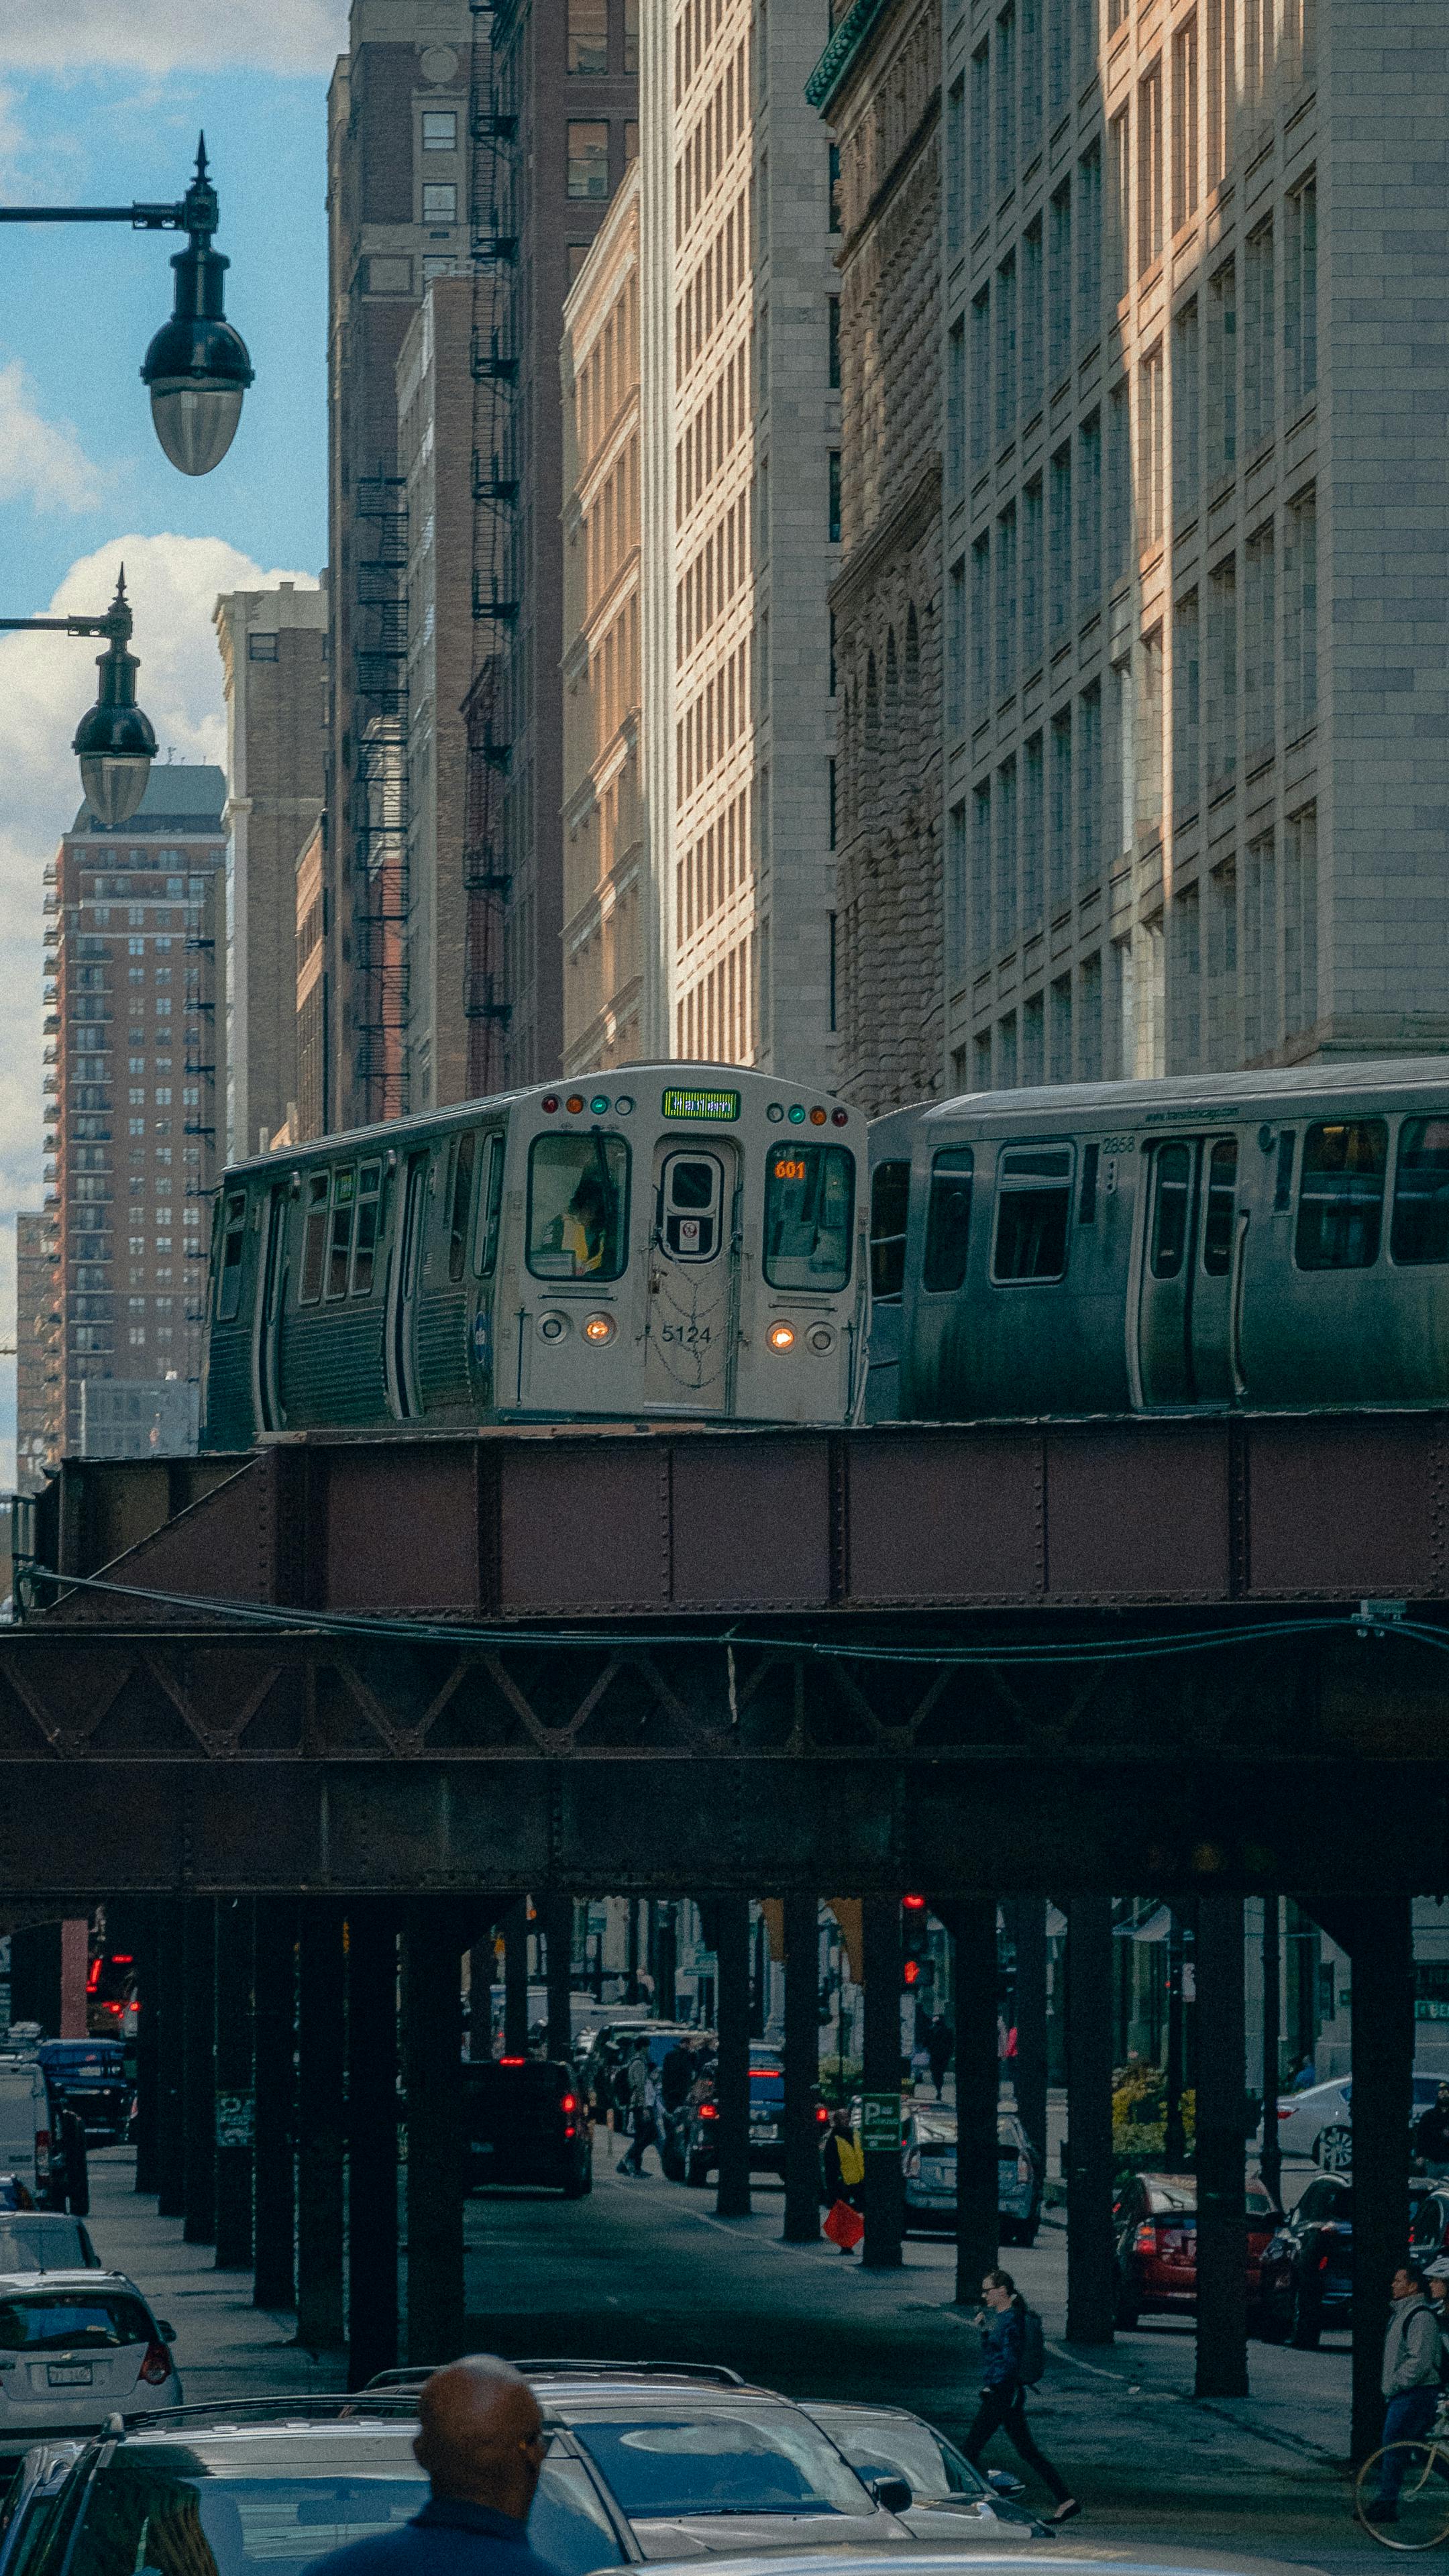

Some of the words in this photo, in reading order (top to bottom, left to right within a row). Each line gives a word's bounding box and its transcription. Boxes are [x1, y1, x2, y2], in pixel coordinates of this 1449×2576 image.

[671, 1095, 731, 1112] Harlem
[774, 1160, 805, 1179] 601
[661, 1324, 712, 1344] 5124
